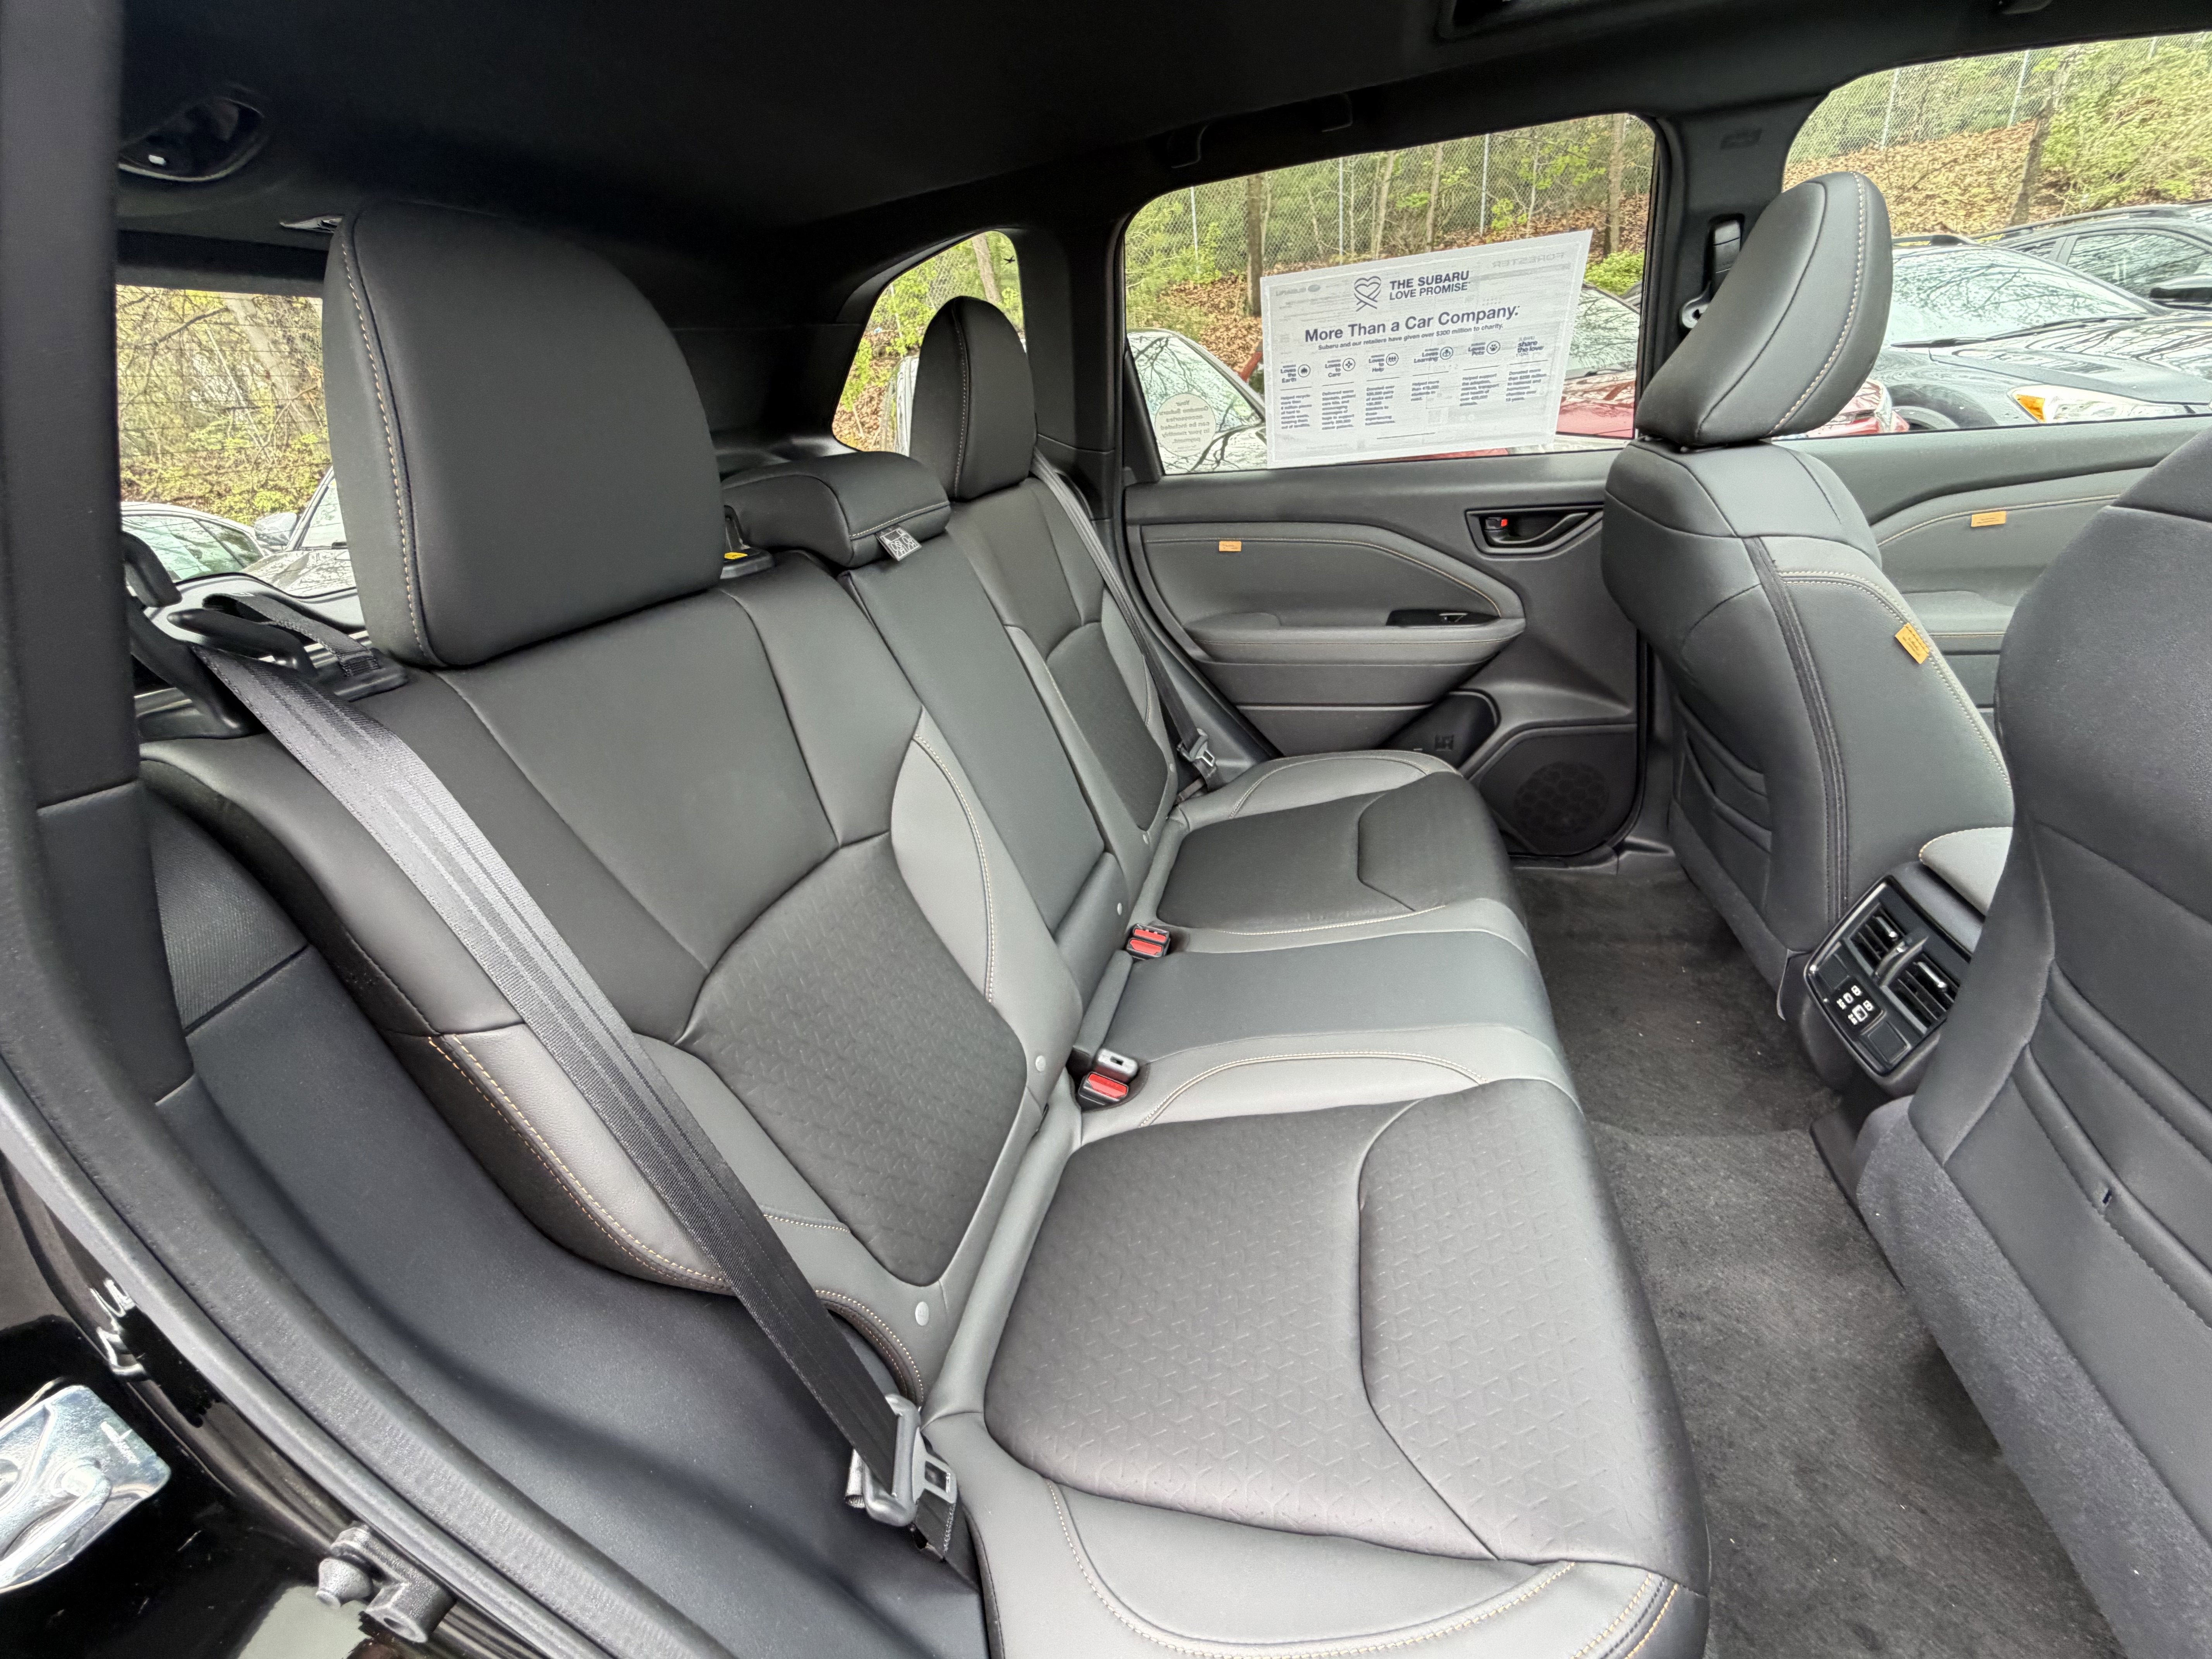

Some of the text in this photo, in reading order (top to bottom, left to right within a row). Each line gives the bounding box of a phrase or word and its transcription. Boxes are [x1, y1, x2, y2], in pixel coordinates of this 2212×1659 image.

[1389, 270, 1469, 290] THE SUBARU
[1389, 282, 1468, 300] LOVE PROMISE
[1305, 329, 1343, 342] More
[1348, 323, 1386, 337] Than
[1391, 322, 1400, 331] a
[1405, 316, 1434, 330] Car
